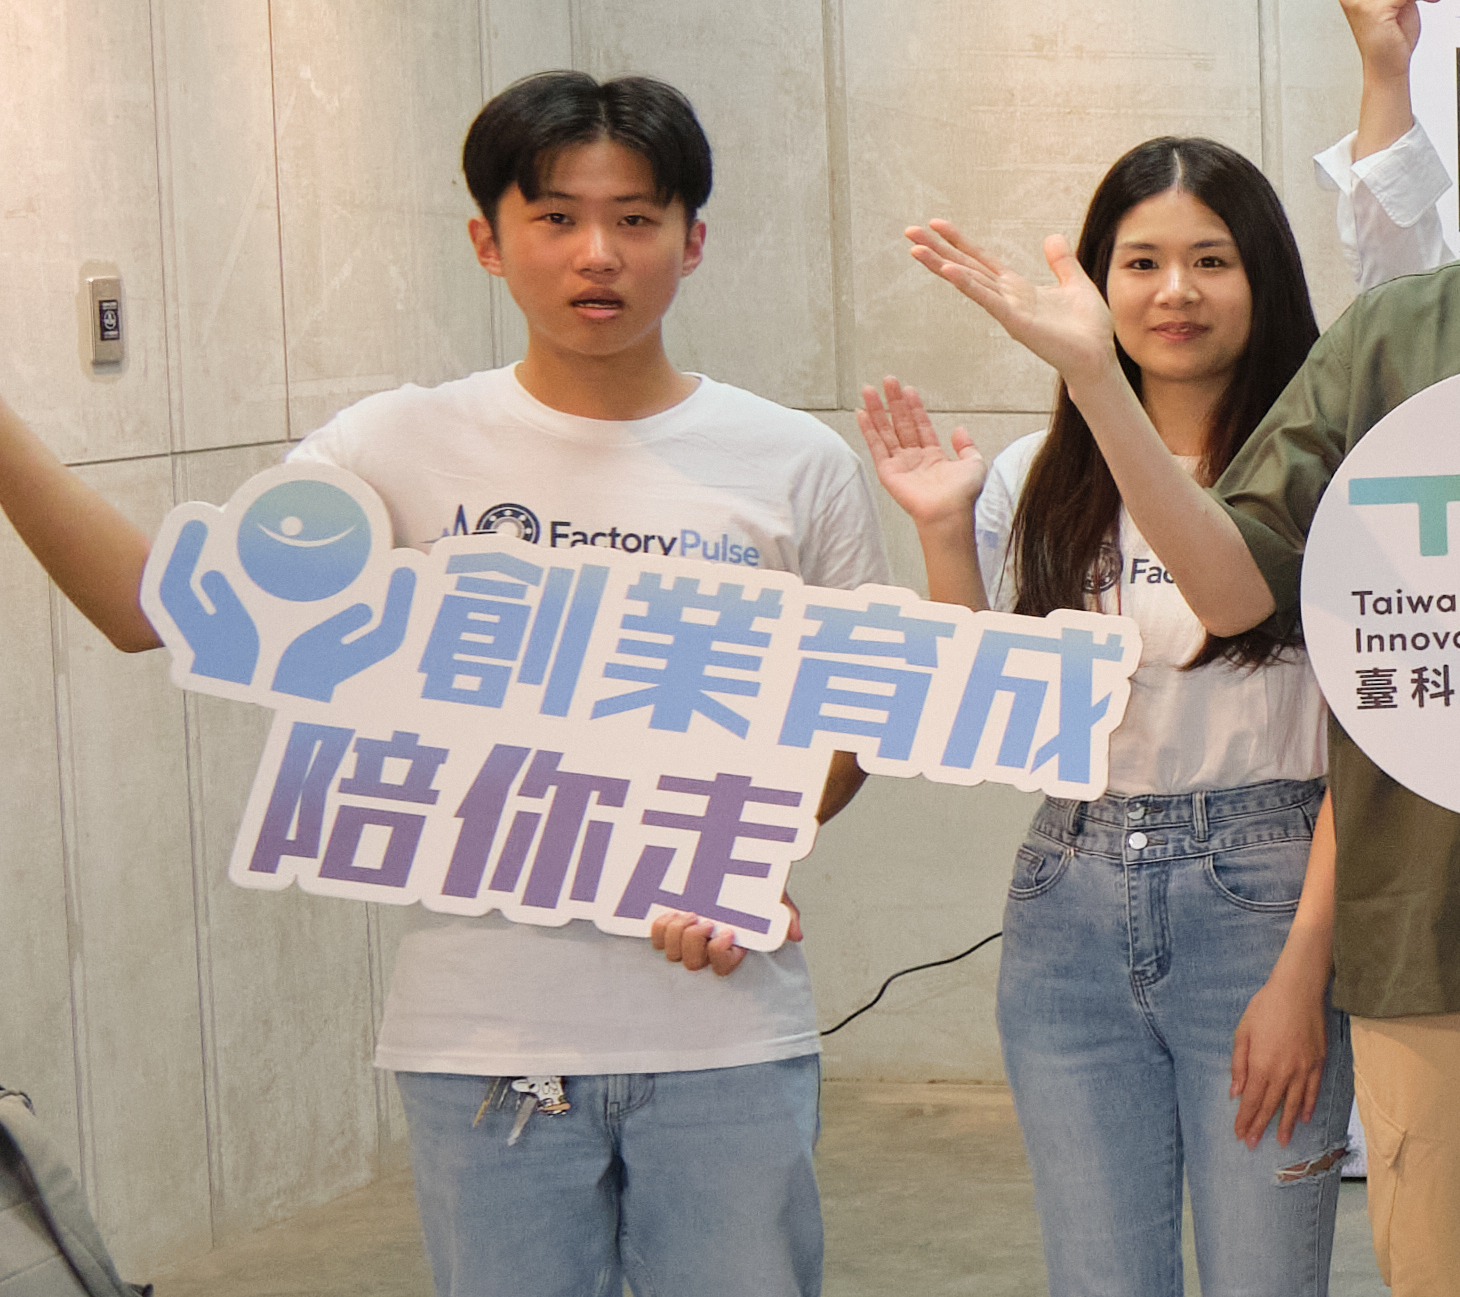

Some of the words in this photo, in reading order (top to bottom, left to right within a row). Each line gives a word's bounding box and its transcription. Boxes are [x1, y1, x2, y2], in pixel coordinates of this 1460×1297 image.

[549, 518, 761, 567] FactoryPulse
[1129, 558, 1176, 585] Fac
[418, 550, 1125, 783] 創業育成
[249, 719, 803, 933] 陪你走
